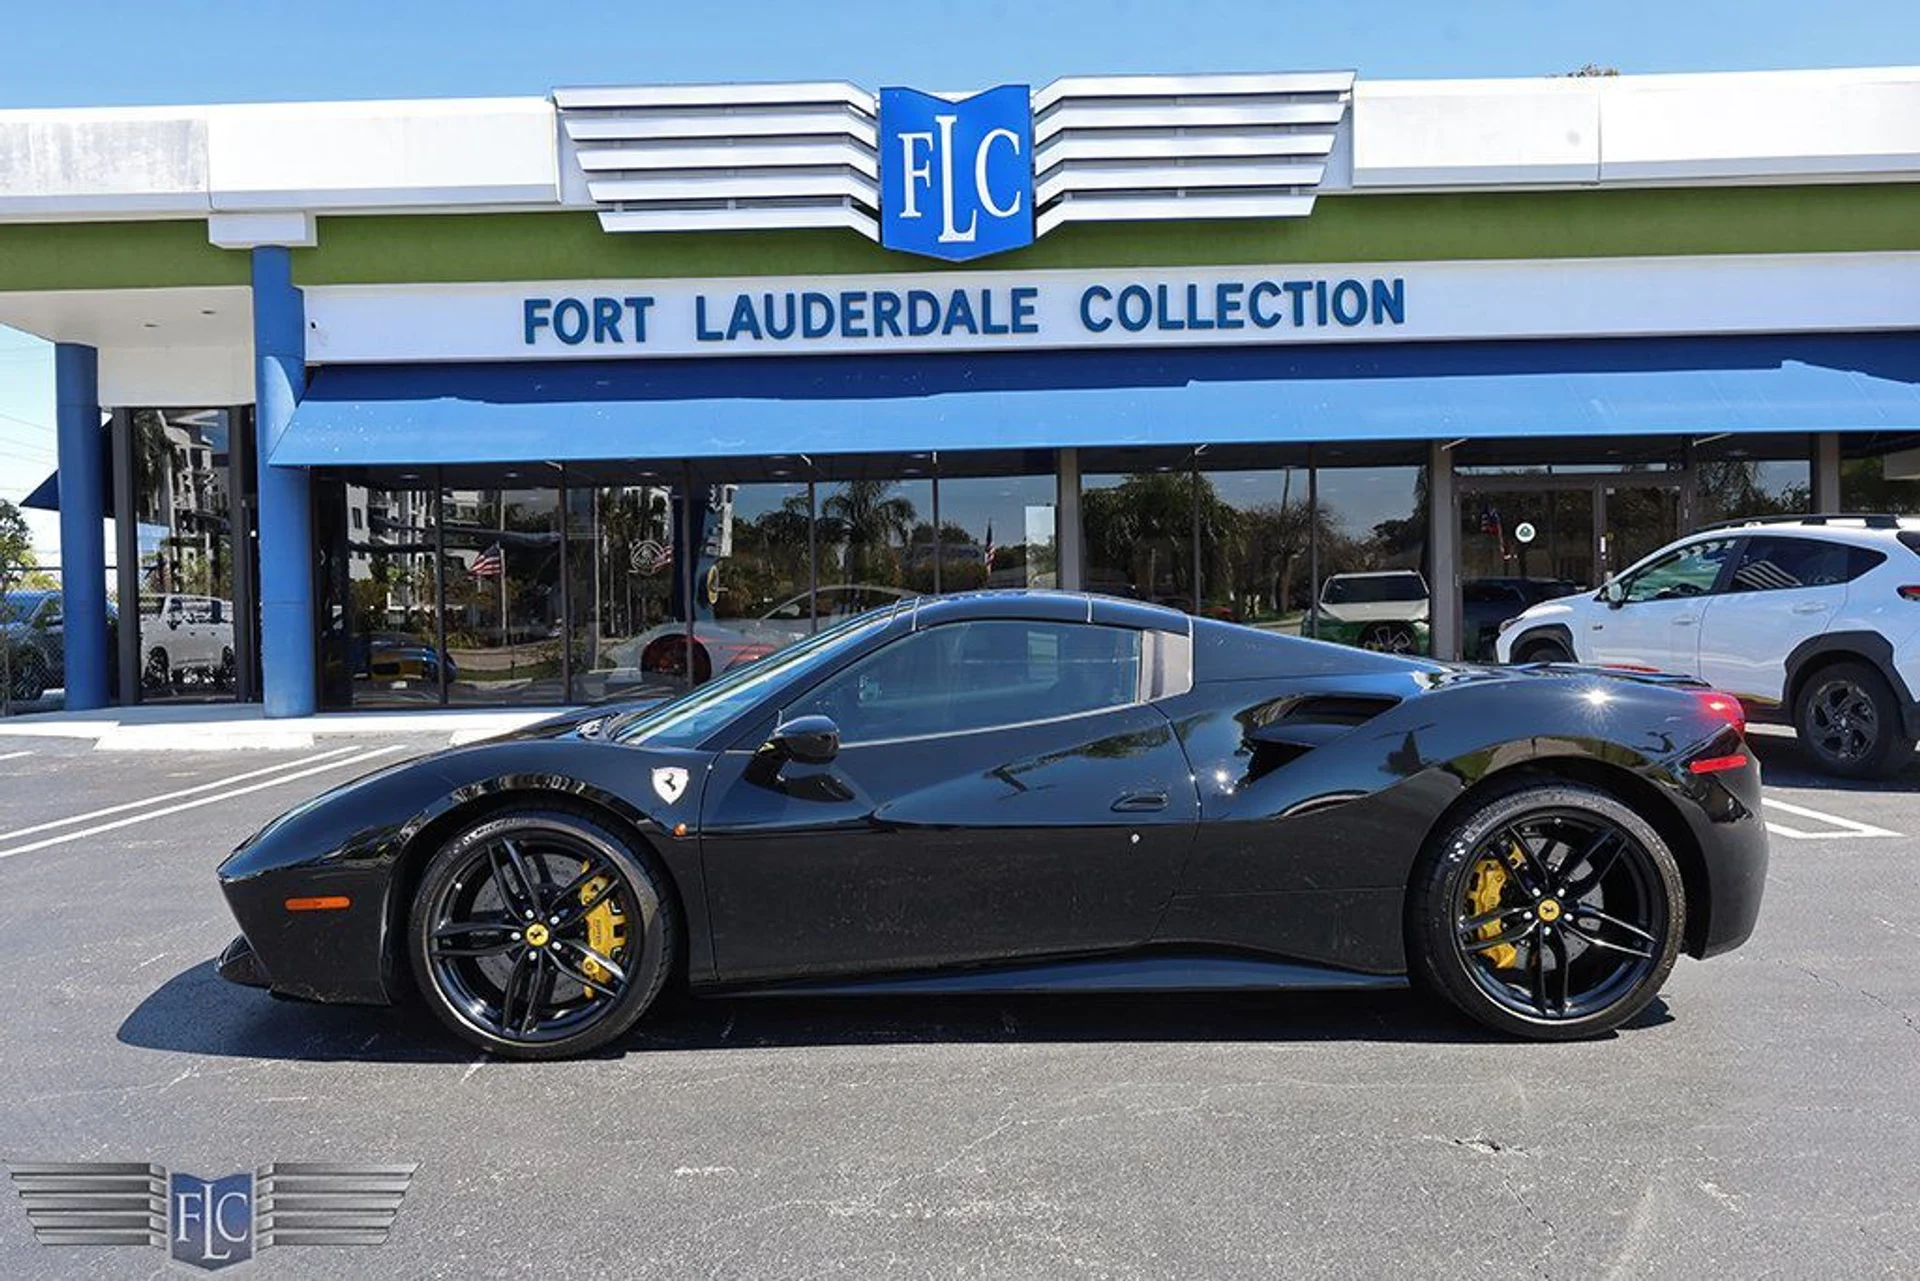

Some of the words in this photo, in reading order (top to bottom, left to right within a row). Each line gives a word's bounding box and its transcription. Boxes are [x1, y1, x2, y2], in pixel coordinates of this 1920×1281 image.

[897, 115, 1021, 243] FLC
[524, 296, 655, 344] FORT
[696, 287, 1039, 342] LAUDERDALE
[1080, 278, 1404, 333] COLLECTION
